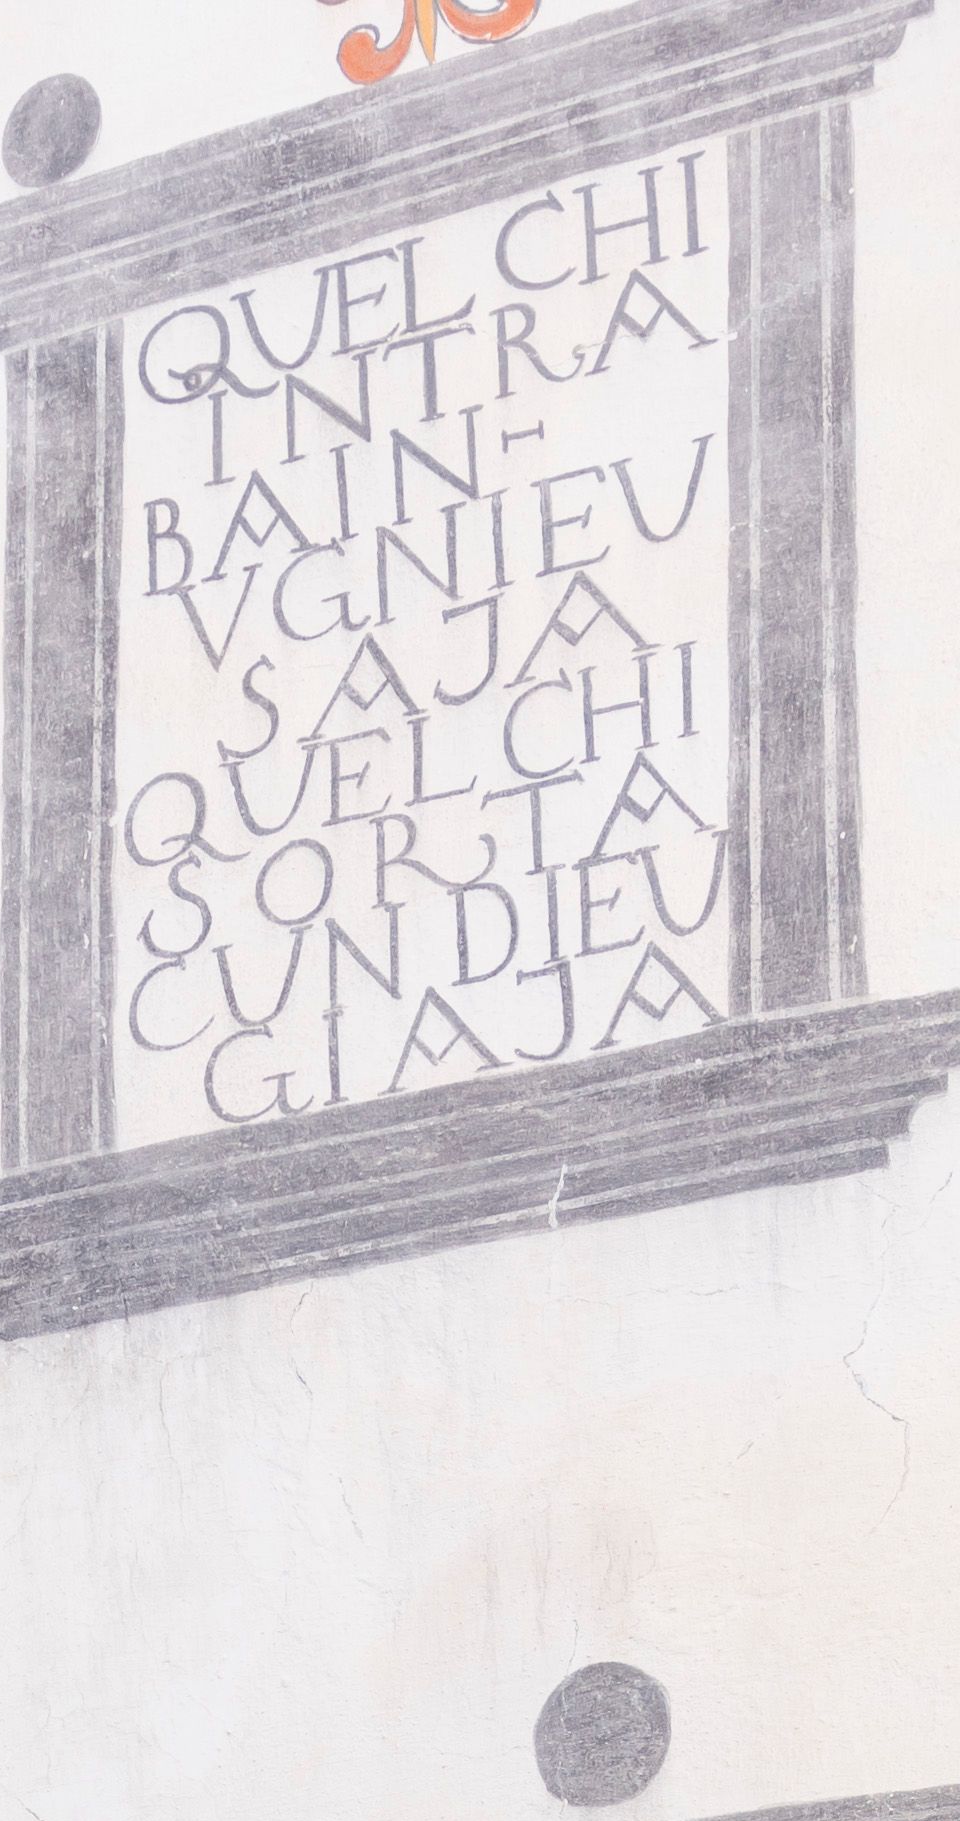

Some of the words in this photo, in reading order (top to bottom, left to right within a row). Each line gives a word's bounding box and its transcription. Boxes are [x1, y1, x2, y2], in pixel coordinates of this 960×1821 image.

[139, 236, 476, 404] QUEL
[494, 151, 709, 290] CHI
[204, 269, 718, 486] INTRA
[143, 404, 544, 597] BAIN-
[170, 434, 715, 672] VGNIEU
[124, 712, 477, 867] QUEL
[503, 641, 700, 779] CHI
[217, 570, 661, 761] SAJA
[129, 903, 408, 1051] CUN
[447, 828, 732, 986] DIEU
[138, 751, 718, 958] SORTA
[204, 941, 730, 1122] GIAJA
